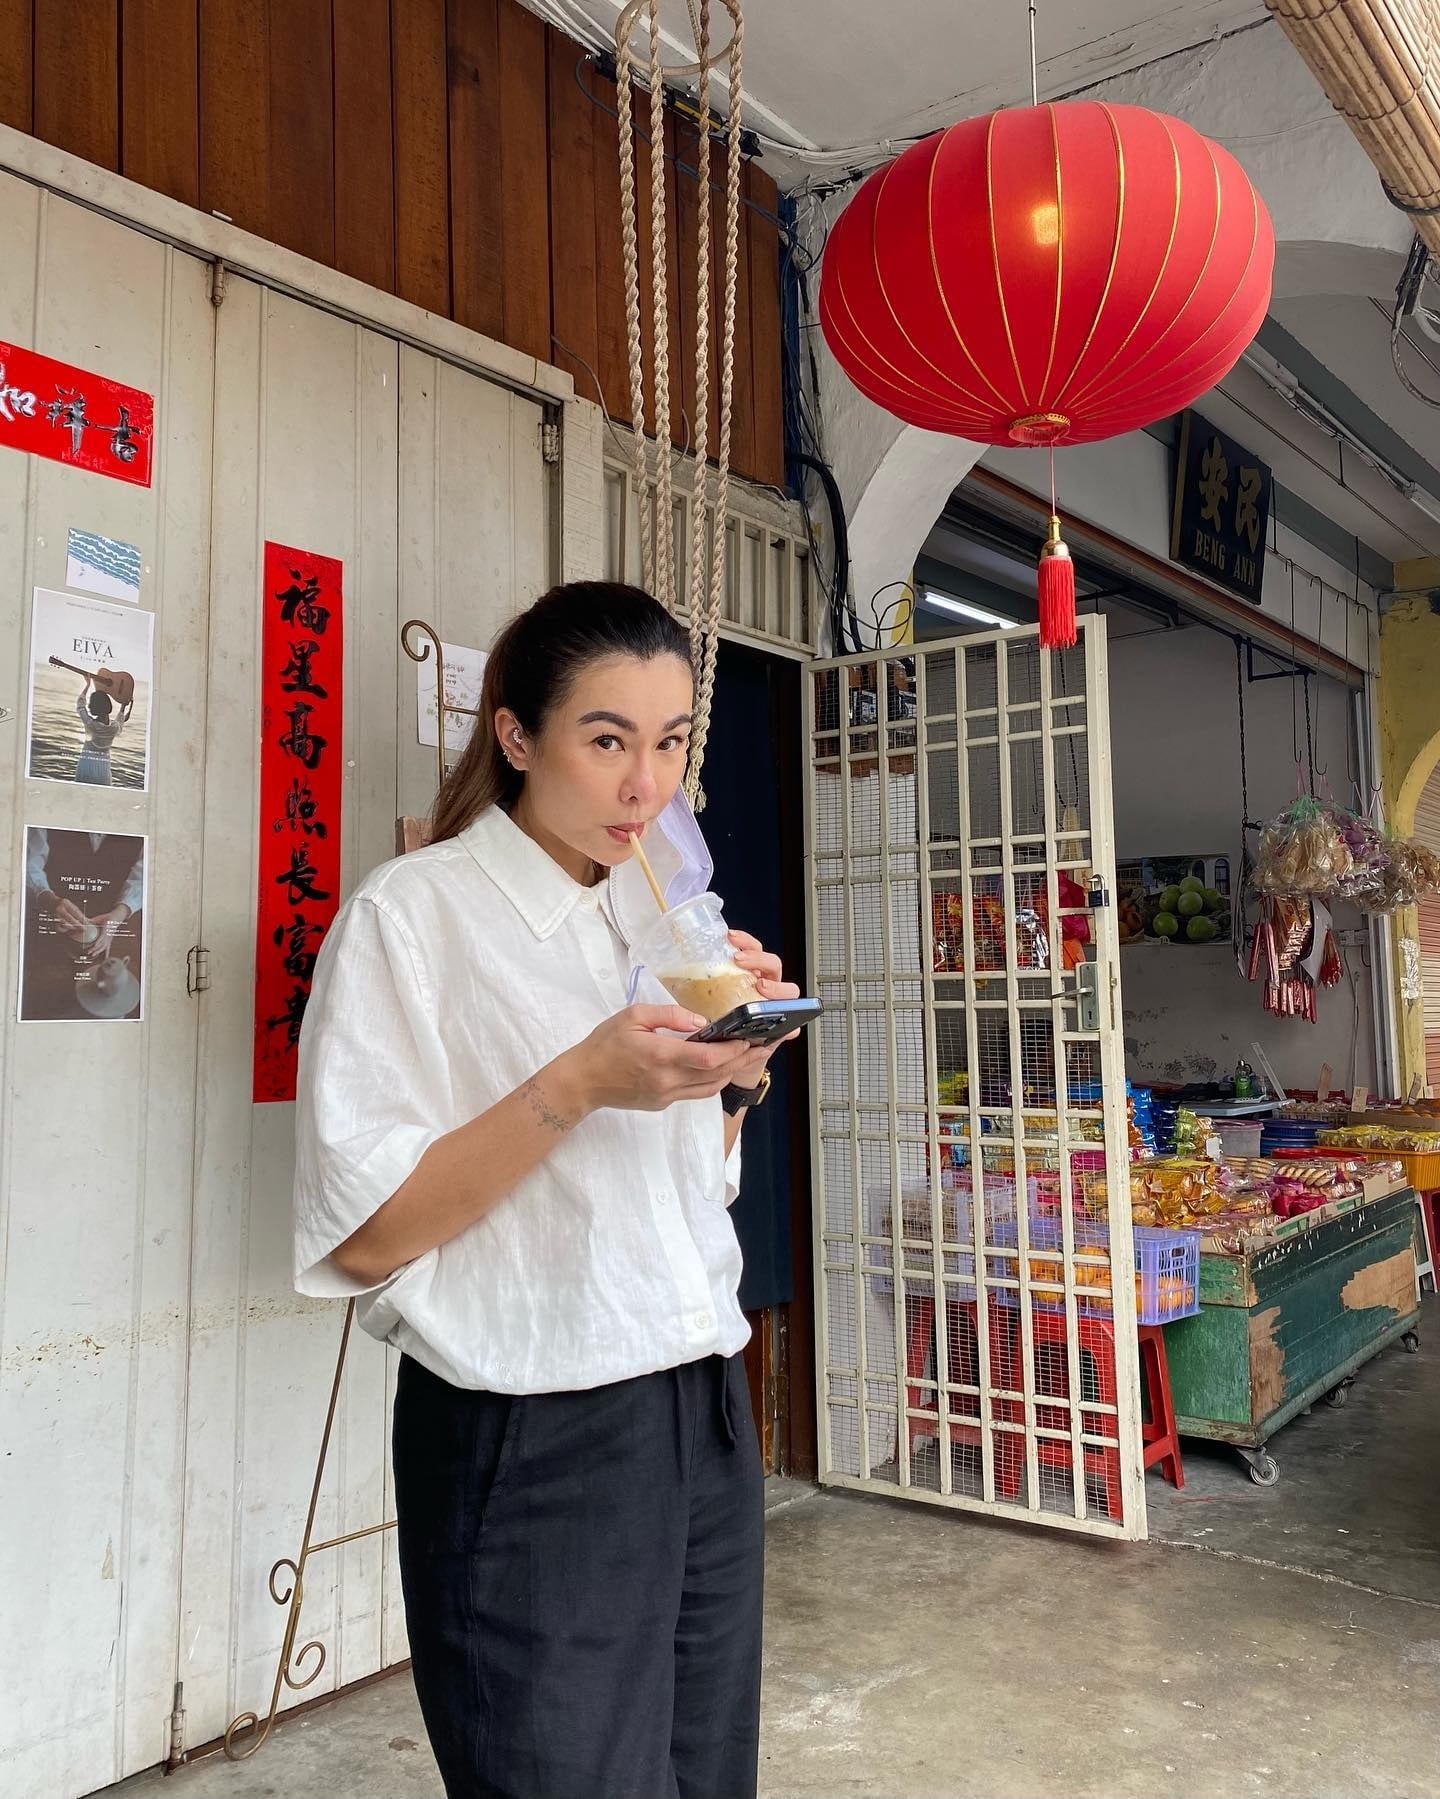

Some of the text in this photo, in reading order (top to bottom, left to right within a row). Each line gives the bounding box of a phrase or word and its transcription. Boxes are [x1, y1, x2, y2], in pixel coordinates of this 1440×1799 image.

[1194, 528, 1257, 588] BENG ANN
[72, 638, 113, 658] EIVA
